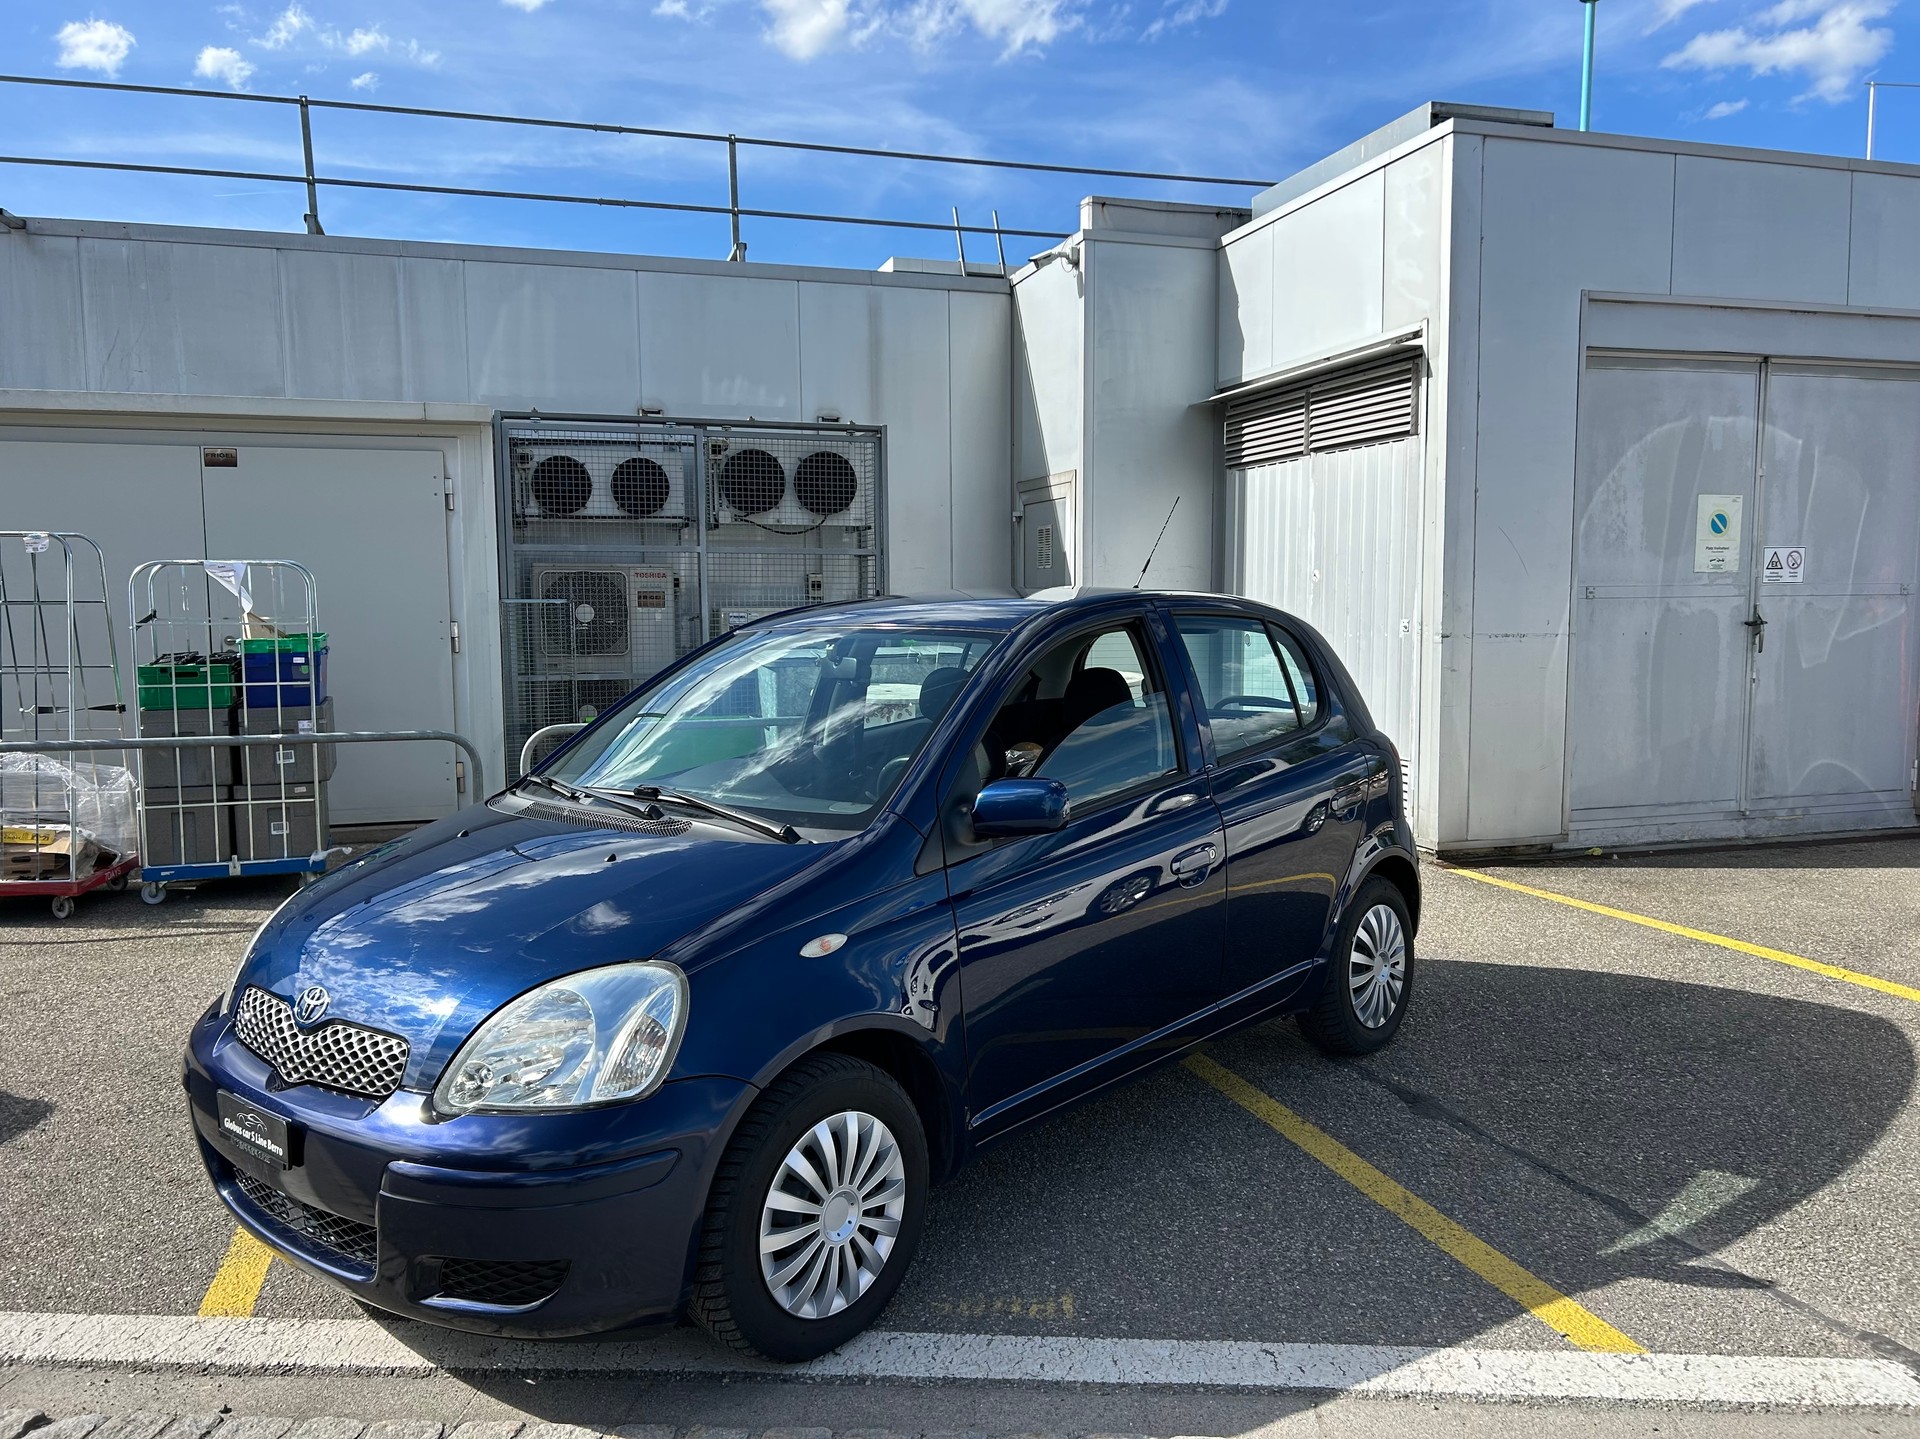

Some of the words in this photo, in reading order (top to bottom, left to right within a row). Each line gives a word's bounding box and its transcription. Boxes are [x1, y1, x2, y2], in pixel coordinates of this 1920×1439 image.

[224, 1117, 242, 1135] Globus
[255, 1132, 267, 1148] Line
[267, 1138, 283, 1156] Berro
